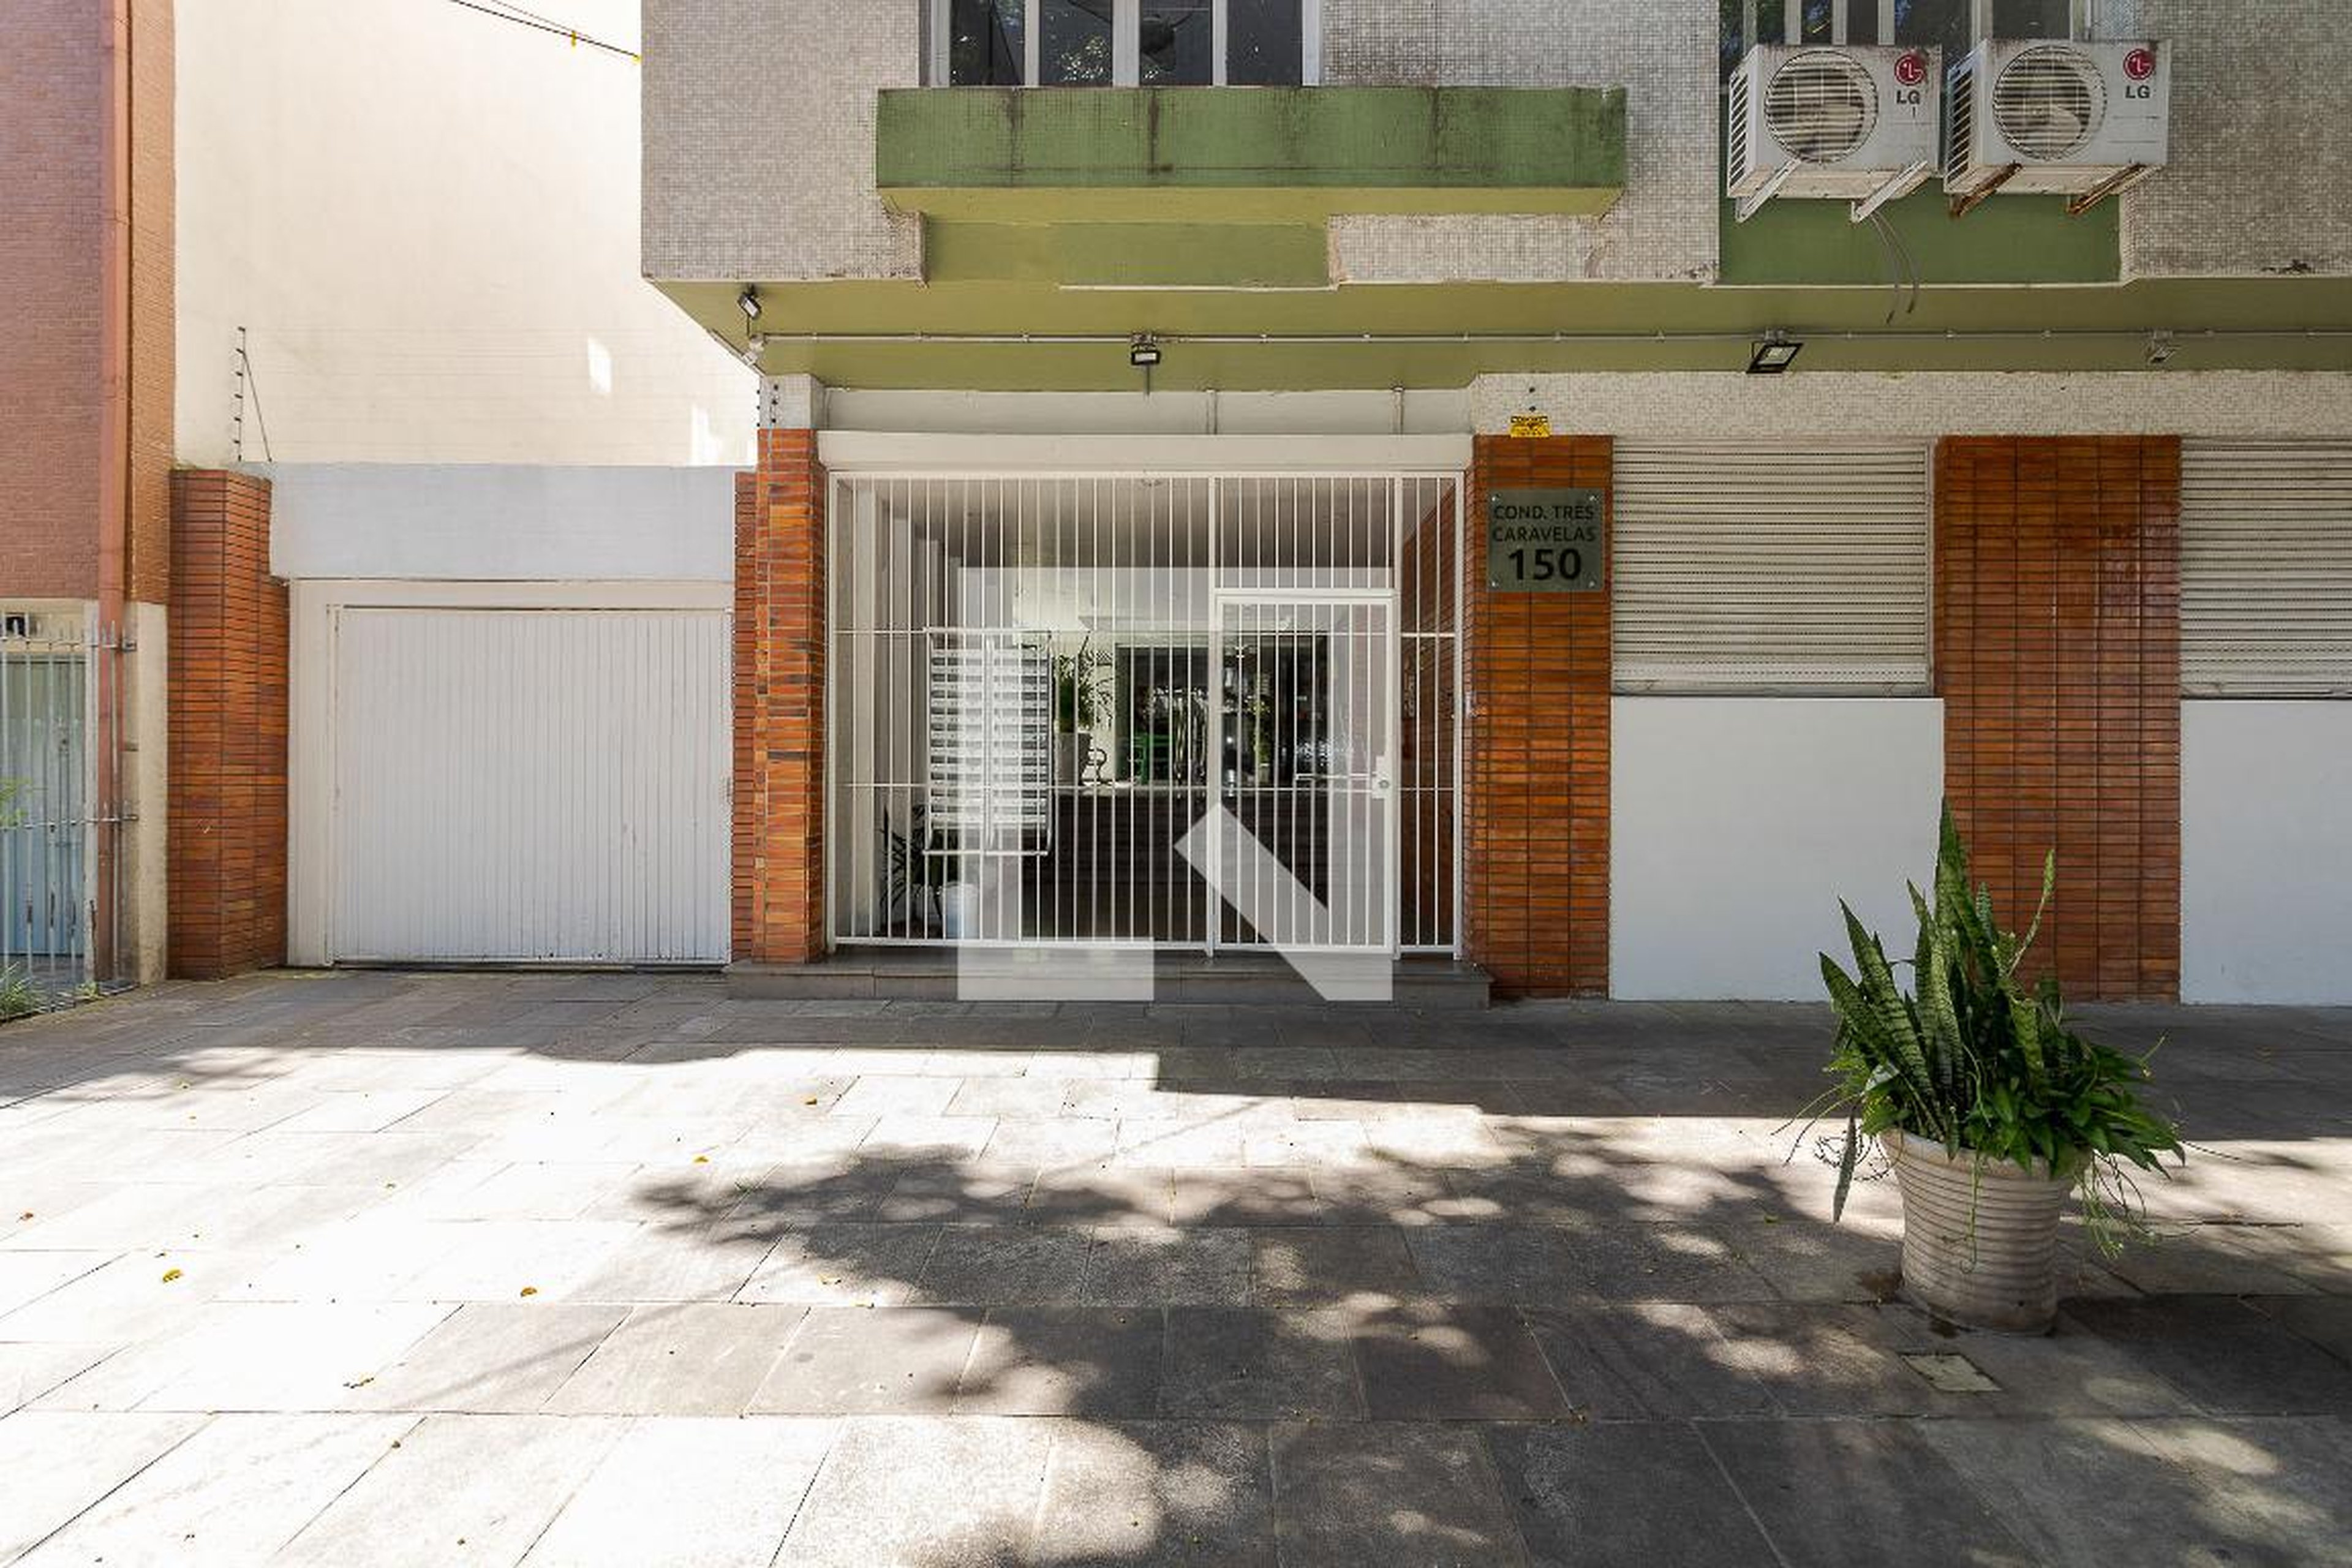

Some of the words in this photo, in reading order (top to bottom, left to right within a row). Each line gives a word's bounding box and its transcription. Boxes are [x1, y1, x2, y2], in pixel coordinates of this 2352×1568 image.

[1896, 90, 1920, 104] LG
[2125, 85, 2150, 99] LG
[1494, 505, 1547, 519] COND.
[1493, 527, 1597, 541] CARAVELAS
[1508, 548, 1582, 580] 150
